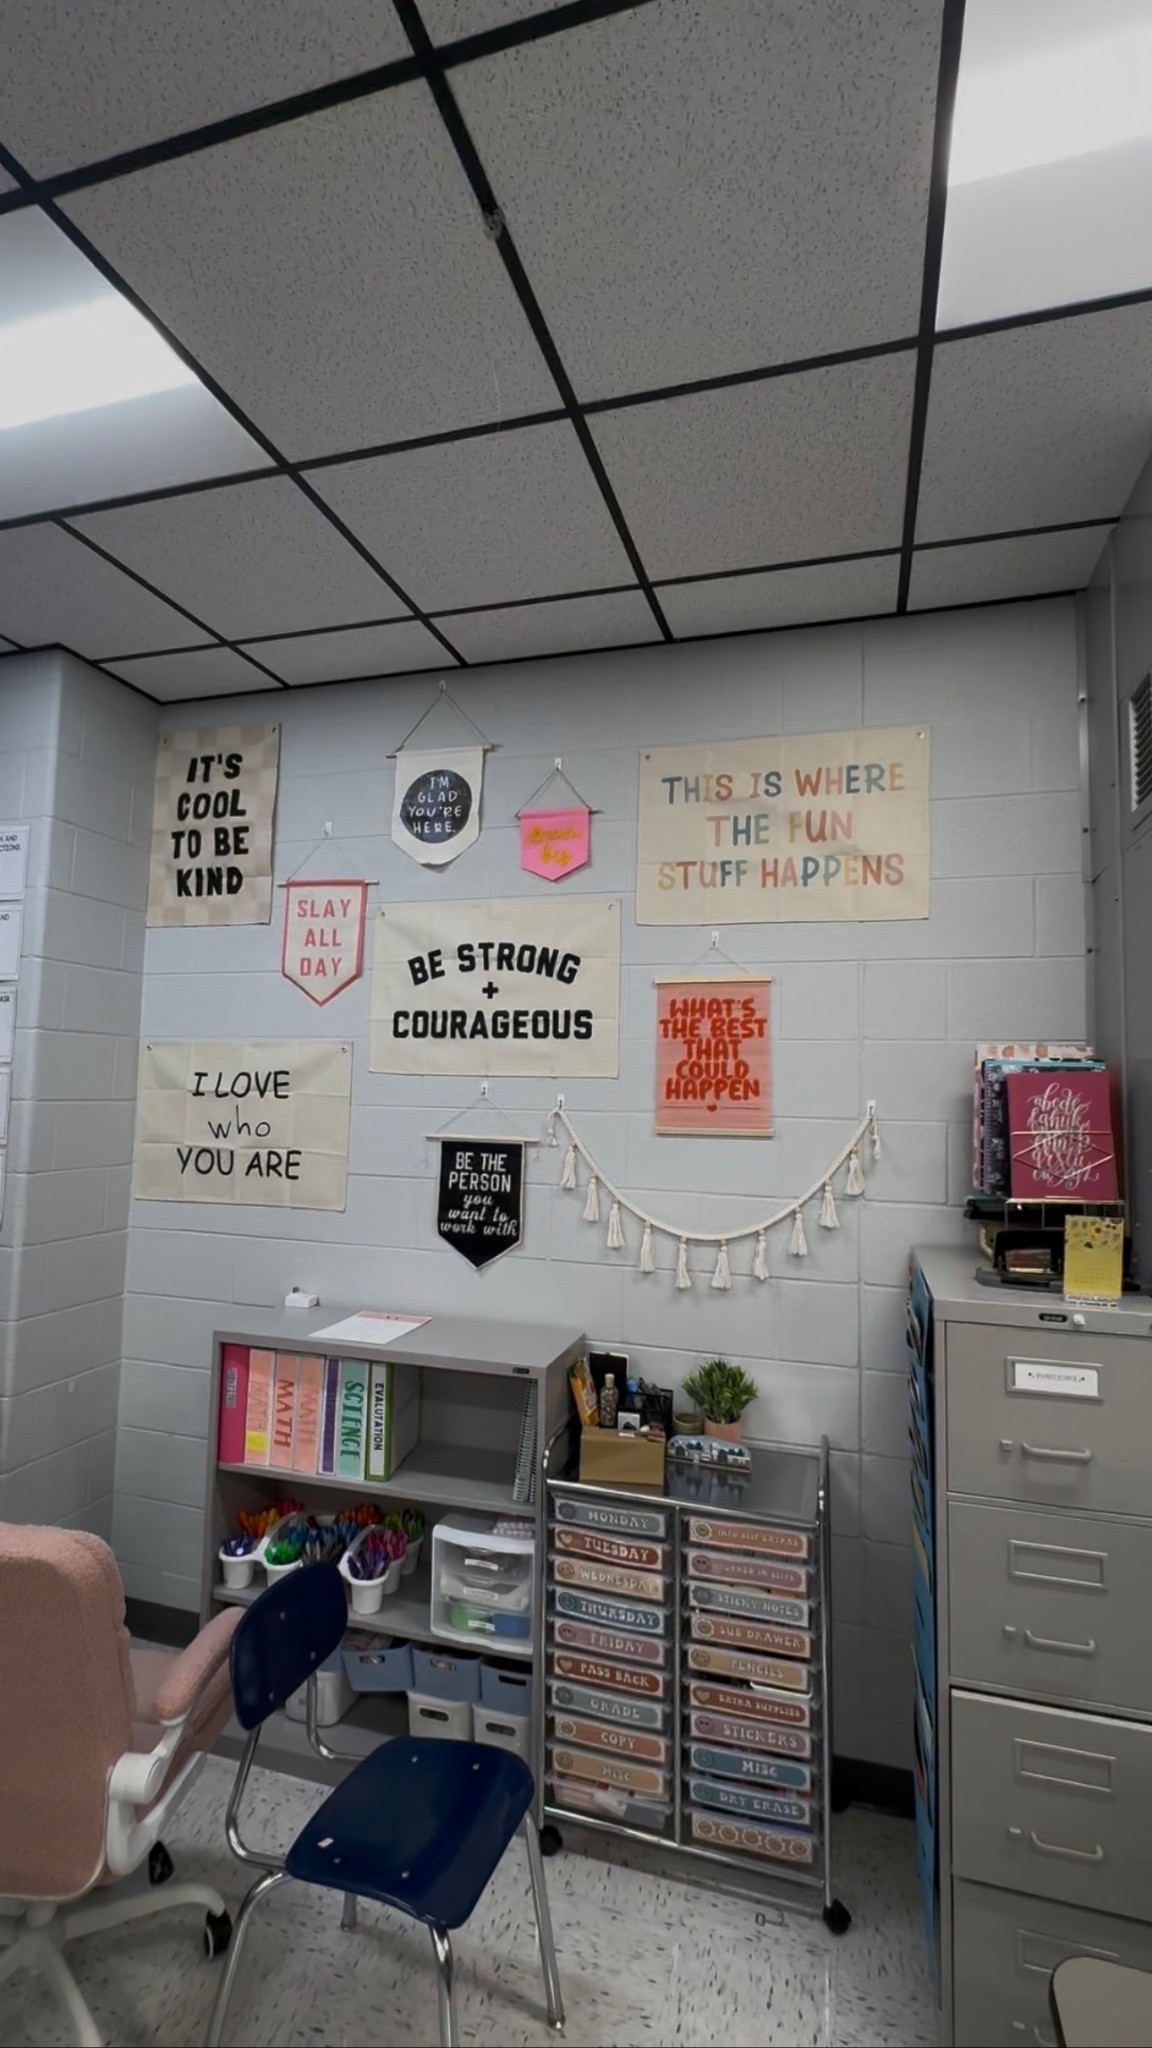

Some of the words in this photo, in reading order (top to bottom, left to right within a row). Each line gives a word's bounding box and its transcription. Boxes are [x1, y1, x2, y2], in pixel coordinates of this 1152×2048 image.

[186, 753, 243, 783] IT'S
[430, 775, 449, 789] I'M
[661, 774, 733, 804] THIS
[750, 771, 782, 798] IS
[795, 763, 904, 796] WHERE
[177, 788, 247, 821] COOL
[417, 790, 458, 803] GLAD
[408, 805, 462, 818] YOU'RE
[413, 821, 456, 833] HERE.
[705, 813, 770, 847] THE
[788, 810, 853, 843] FUN
[171, 829, 202, 859] TO
[214, 826, 250, 857] BE
[176, 866, 244, 897] KIND
[657, 860, 748, 890] STUFF
[761, 853, 904, 889] HAPPENS
[297, 899, 351, 918] SLAY
[304, 928, 342, 947] ALL
[300, 957, 342, 976] DAY
[407, 949, 445, 986] BE
[457, 942, 581, 985] STRONG
[669, 998, 756, 1019] WHAT'S
[392, 1009, 593, 1039] COURAGEOUS
[659, 1018, 702, 1039] THE
[710, 1018, 768, 1039] BEST
[683, 1038, 742, 1060] THAT
[675, 1060, 750, 1080] COULD
[192, 1072, 208, 1096] I
[214, 1071, 290, 1099] LOVE
[666, 1078, 760, 1101] HAPPEN
[207, 1104, 271, 1139] who
[176, 1147, 234, 1175] YOU
[245, 1150, 302, 1180] ARE
[455, 1152, 474, 1170] BE
[481, 1153, 508, 1172] THE
[448, 1171, 511, 1192] PERSON
[464, 1194, 494, 1209] you
[448, 1206, 486, 1221] want
[493, 1207, 509, 1222] to
[440, 1220, 477, 1234] work
[483, 1219, 518, 1236] with
[273, 1379, 295, 1447] MATH
[340, 1380, 364, 1460] SCIENCE
[588, 1511, 649, 1528] MONDAY
[584, 1537, 650, 1561] TUESDAY
[580, 1601, 658, 1625] THURSDAY
[718, 1595, 757, 1609] STICKY
[763, 1602, 799, 1617] NOTES
[591, 1633, 644, 1653] FRIDAY
[720, 1627, 741, 1637] SUB
[747, 1631, 801, 1648] DRAWER
[580, 1662, 610, 1678] PASS
[616, 1672, 650, 1687] BACK
[731, 1659, 784, 1679] PENCILS
[590, 1699, 641, 1719] GRADE
[756, 1703, 801, 1717] SUPPLIES
[601, 1732, 636, 1749] COPY
[723, 1724, 798, 1748] STICKERS
[603, 1766, 631, 1782] MISC
[742, 1760, 778, 1777] MISC
[720, 1792, 746, 1806] DRY
[754, 1799, 800, 1815] ERASE
